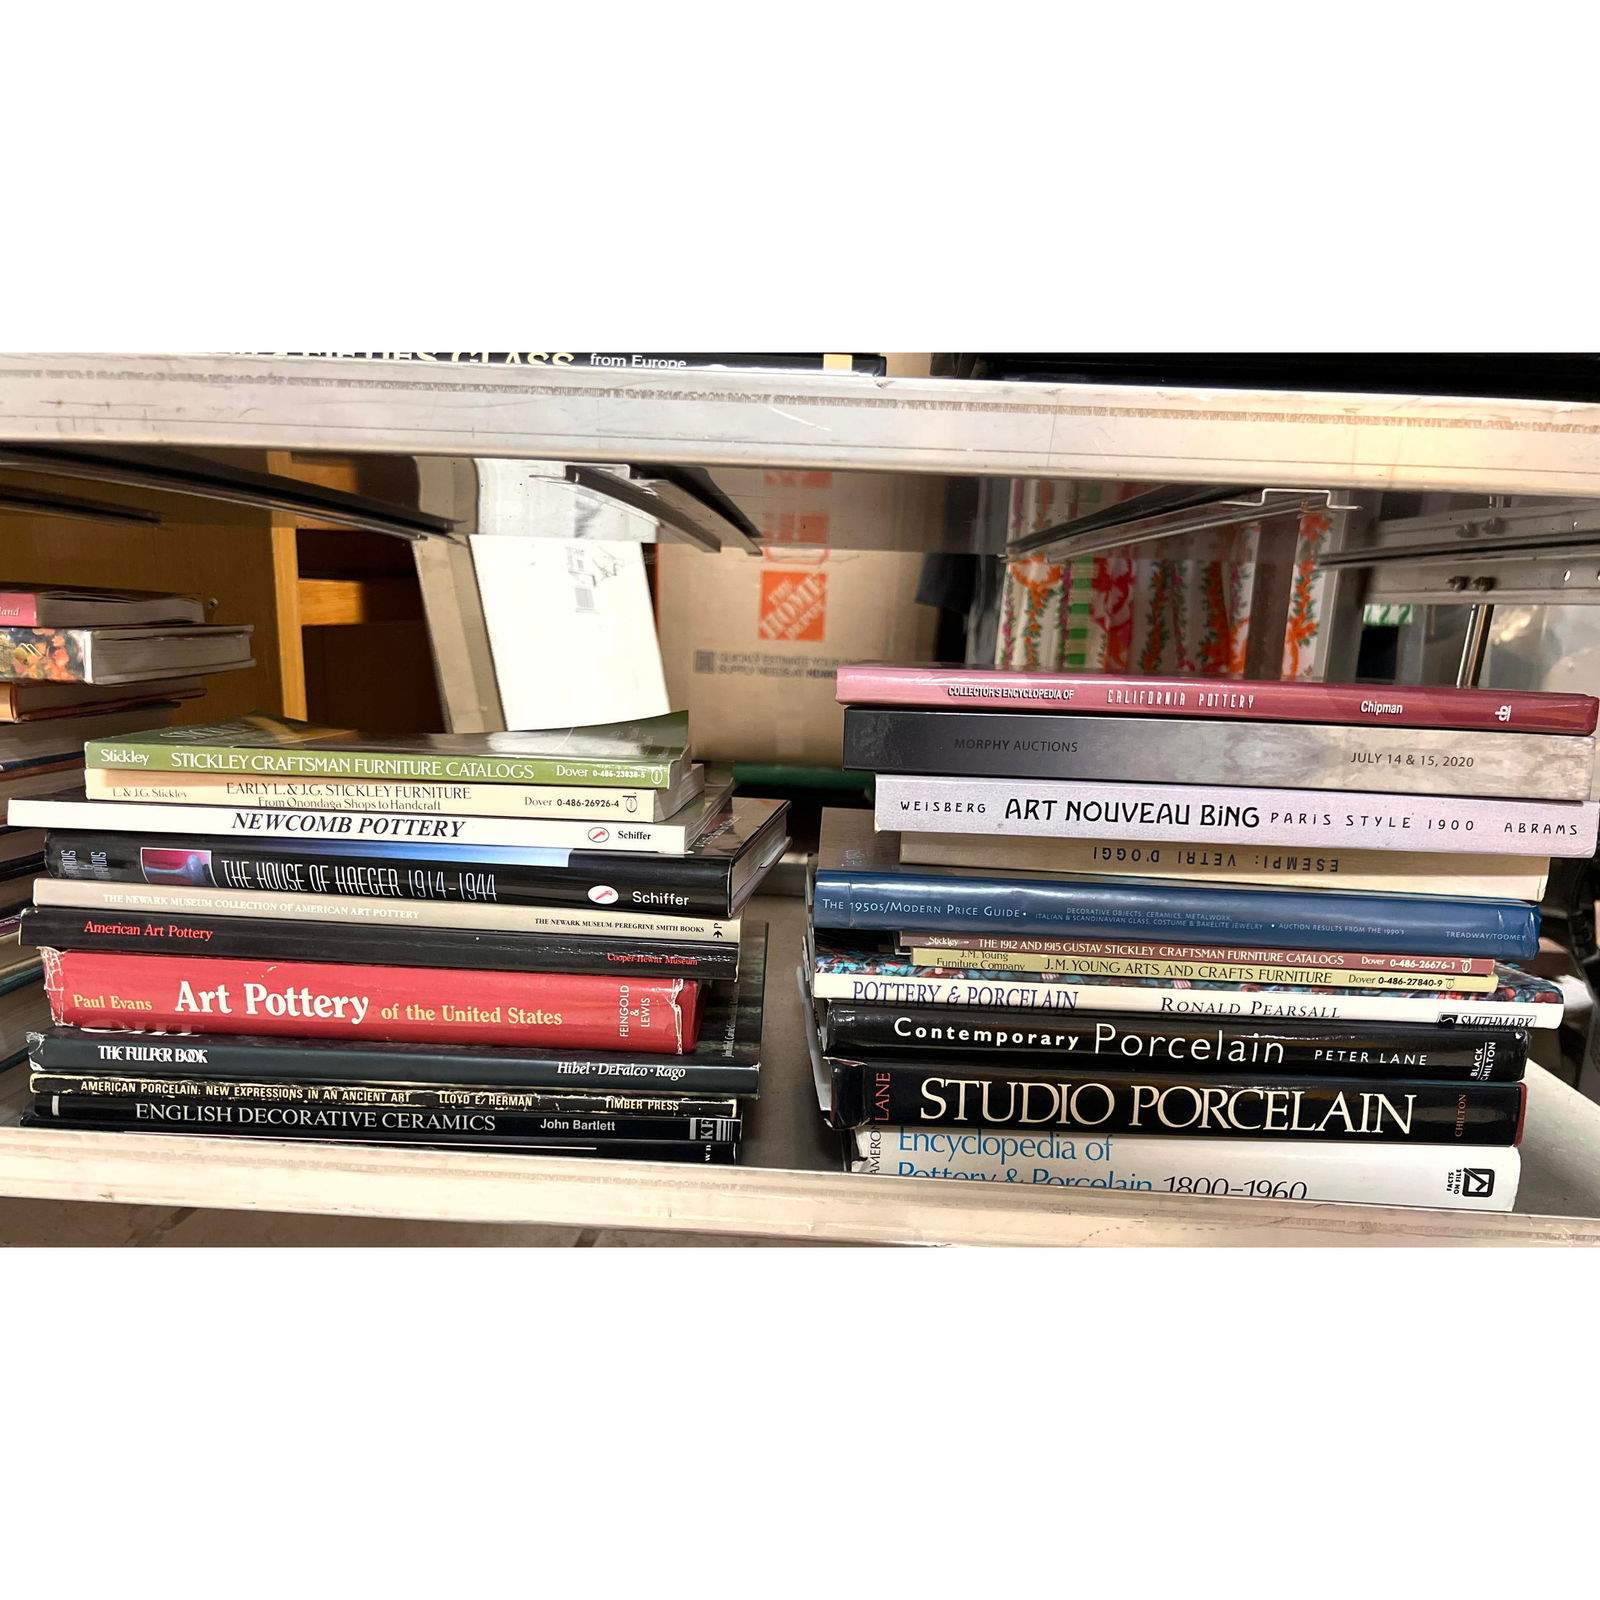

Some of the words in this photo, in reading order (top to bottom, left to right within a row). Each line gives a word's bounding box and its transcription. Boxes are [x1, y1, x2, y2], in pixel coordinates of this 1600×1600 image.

[590, 353, 626, 366] from
[632, 355, 687, 369] Europe
[947, 685, 1001, 698] COLLECTOR'S
[1002, 688, 1062, 700] ENCYCLOPEDIA
[1062, 690, 1075, 700] OF
[1107, 689, 1186, 706] CALIFORNIA
[1198, 693, 1254, 709] POTTERY
[1360, 701, 1403, 716] Chipman
[954, 738, 1010, 751] MORPHY
[1013, 740, 1078, 753] AUCTIONS
[100, 749, 149, 766] Stickley
[171, 752, 249, 770] STICKLEY
[251, 755, 350, 773] CRAFTSMAN
[354, 758, 443, 777] FURNITURE
[446, 761, 535, 779] CATALOGS
[1350, 752, 1382, 764] JULY
[1387, 753, 1402, 765] 14
[1406, 754, 1415, 766] &
[1420, 755, 1439, 768] 15,
[1443, 756, 1474, 768] 2020
[556, 765, 589, 778] Dover
[152, 789, 188, 799] Stickley
[226, 782, 271, 795] EARLY
[287, 783, 297, 796] &
[302, 783, 322, 797] J.G.
[325, 785, 392, 798] STICKLEY
[395, 786, 471, 800] FURNITURE
[258, 797, 285, 808] From
[287, 797, 342, 810] Onondaga
[344, 799, 376, 811] Shops
[378, 799, 388, 809] to
[390, 800, 441, 811] Handcraft
[524, 796, 552, 807] Dover
[557, 798, 619, 808] 0-486-26926-4
[900, 800, 987, 814] WEISBERG
[1005, 798, 1058, 820] ART
[1065, 799, 1191, 825] NOUVEAU
[232, 812, 352, 833] NEWCOMB
[357, 817, 466, 838] POTTERY
[1346, 814, 1411, 829] STYLE
[1428, 819, 1475, 832] 1900
[1504, 822, 1578, 836] ABRAMS
[618, 830, 652, 841] Schiffer
[1178, 851, 1236, 867] VETRI
[221, 860, 252, 888] THE
[256, 862, 307, 892] HOUSE
[309, 864, 331, 893] OF
[334, 865, 403, 897] HAEGER
[408, 869, 497, 902] 1914-1944
[104, 894, 123, 904] THE
[125, 895, 168, 906] NEWARK
[170, 897, 213, 908] MUSEUM
[215, 898, 277, 911] COLLECTION
[279, 901, 294, 912] OF
[296, 902, 348, 915] AMERICAN
[350, 907, 371, 917] ART
[373, 908, 419, 919] POTTERY
[632, 891, 689, 906] Schiffer
[1066, 907, 1111, 916] DECORATIVE
[535, 917, 548, 926] THE
[551, 919, 581, 927] NEWARK
[656, 923, 679, 932] SMITH
[680, 924, 705, 933] BOOKS
[1035, 913, 1063, 921] ITALIAN
[1072, 915, 1126, 924] SCANDINAVIAN
[1153, 918, 1187, 927] COSTUME
[1196, 920, 1230, 929] BAKELITE
[1231, 922, 1263, 930] JEWELRY
[1278, 922, 1311, 931] AUCTION
[1312, 924, 1343, 932] RESULTS
[1344, 925, 1366, 934] FROM
[1367, 926, 1382, 934] THE
[84, 921, 141, 936] American
[144, 923, 165, 938] Art
[168, 925, 213, 942] Pottery
[928, 937, 959, 947] Stickley
[978, 939, 998, 949] THE
[1000, 940, 1018, 949] 1912
[1020, 940, 1042, 950] AND
[1044, 941, 1062, 951] 1915
[1063, 942, 1103, 953] GUSTAV
[1105, 944, 1155, 956] STICKLEY
[1159, 946, 1225, 959] CRAFTSMAN
[1227, 950, 1283, 962] FURNITURE
[1286, 953, 1344, 965] CATALOGS
[937, 958, 978, 968] Furniture
[980, 960, 1026, 971] Company
[1044, 958, 1069, 971] J.M.
[1072, 960, 1120, 974] YOUNG
[1124, 962, 1160, 975] ARTS
[1164, 964, 1194, 977] AND
[1198, 966, 1253, 980] CRAFTS
[1258, 969, 1333, 983] FURNITURE
[1361, 956, 1385, 966] Dover
[1390, 959, 1455, 970] 0-486-26676-1
[1348, 974, 1376, 984] Dover
[1378, 976, 1443, 987] 0-486-27840-9
[73, 994, 105, 1010] Paul
[111, 996, 153, 1011] Evans
[175, 980, 233, 1014] Art
[243, 983, 369, 1025] Pottery
[381, 1003, 401, 1020] of
[405, 1004, 436, 1021] the
[442, 1005, 501, 1023] United
[508, 1007, 563, 1025] States
[853, 981, 941, 1001] POTTERY
[947, 986, 961, 1004] &
[967, 987, 1079, 1010] PORCELAIN
[619, 985, 630, 1037] FEINGOLD
[640, 997, 651, 1027] LEWIS
[1160, 997, 1241, 1014] RONALD
[1252, 1001, 1341, 1018] PEARSALL
[894, 1017, 1079, 1051] Contemporary
[1095, 1023, 1284, 1064] Porcelain
[97, 1045, 123, 1061] THE
[1315, 1049, 1369, 1063] PETER
[1380, 1053, 1428, 1066] LANE
[1470, 1047, 1484, 1076] BLACK
[557, 1062, 591, 1075] Hibel
[655, 1066, 686, 1080] Rago
[81, 1082, 136, 1093] AMERICAN
[140, 1083, 201, 1095] PORCELAIN:
[206, 1085, 230, 1096] NEW
[234, 1086, 303, 1099] EXPRESSIONS
[307, 1088, 319, 1099] IN
[323, 1089, 338, 1100] AN
[342, 1090, 387, 1102] ANCIENT
[390, 1091, 411, 1103] ART
[439, 1093, 470, 1105] LLOYD
[488, 1095, 533, 1107] HERMAN
[875, 1072, 891, 1122] LANE
[605, 1099, 643, 1110] TIMBER
[648, 1101, 679, 1111] PRESS
[920, 1077, 1115, 1126] STUDIO
[1128, 1084, 1417, 1135] PORCELAIN
[136, 1103, 232, 1123] ENGLISH
[238, 1107, 377, 1128] DECORATIVE
[381, 1113, 496, 1132] CERAMICS
[1455, 1094, 1467, 1137] CHILTON
[540, 1118, 570, 1131] John
[573, 1119, 616, 1132] Bartlett
[899, 1127, 1077, 1165] Encyclopedia
[1085, 1135, 1113, 1162] of
